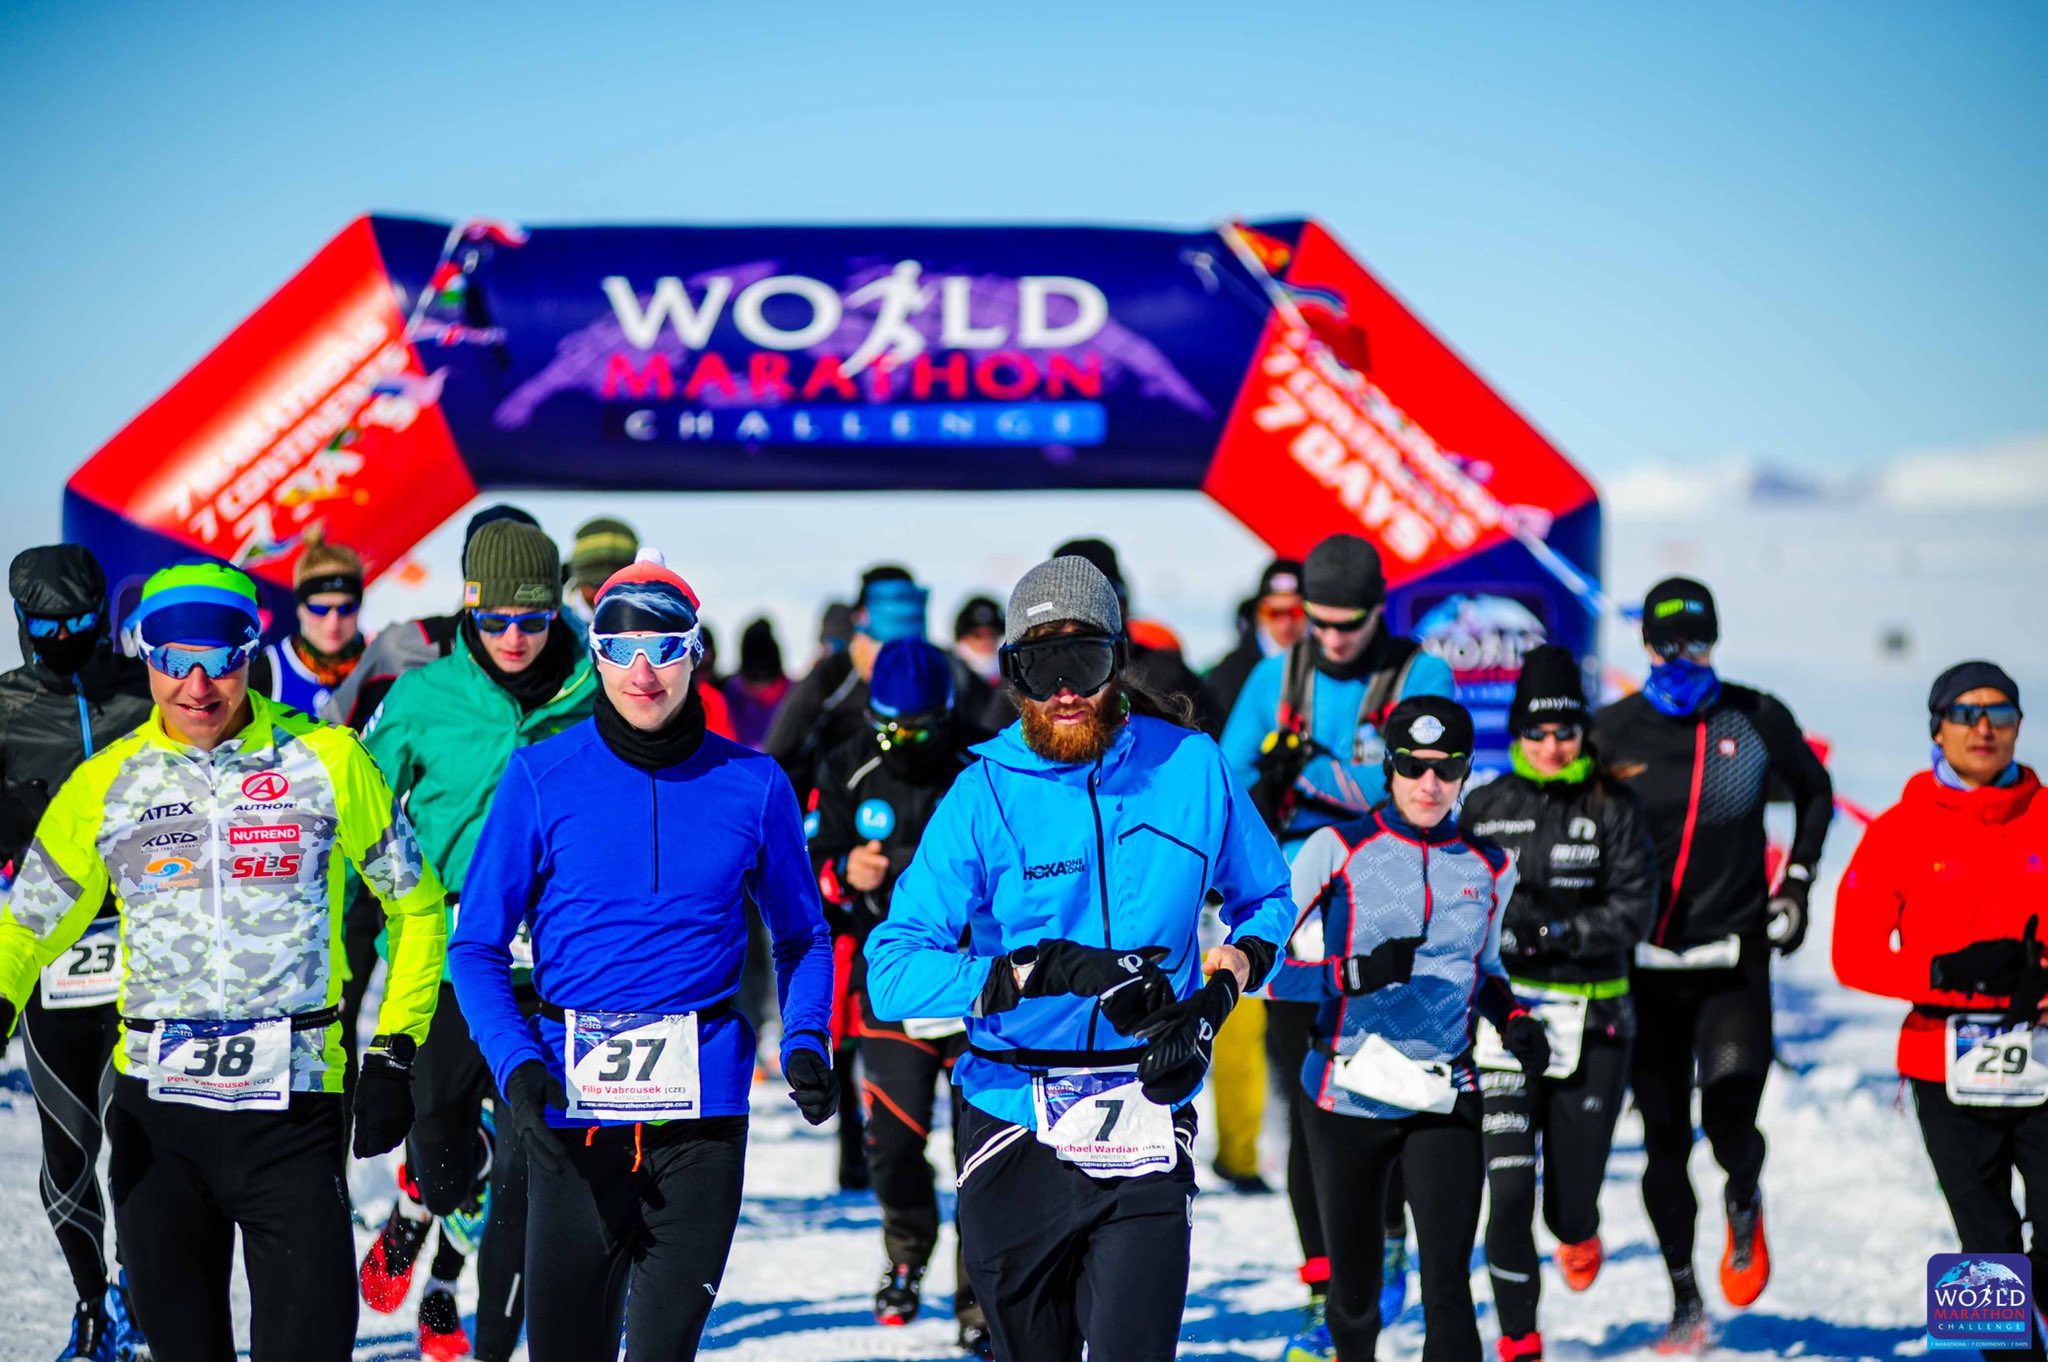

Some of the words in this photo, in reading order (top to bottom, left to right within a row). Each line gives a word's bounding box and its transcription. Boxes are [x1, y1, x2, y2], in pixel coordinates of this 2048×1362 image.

[602, 351, 1101, 399] MARATHON
[623, 409, 1074, 441] CHALLENGE
[189, 506, 219, 543] 7
[216, 343, 411, 516] CONTINENTS
[1254, 388, 1306, 432] 7
[1291, 422, 1434, 562] DAYS
[139, 801, 193, 822] ATEX
[233, 803, 293, 812] AUTHOR
[142, 833, 198, 848] TUFO
[233, 829, 296, 841] NUTREND
[1023, 861, 1067, 880] HOKA
[1065, 858, 1083, 867] ONE
[1067, 864, 1085, 874] ONE
[69, 944, 116, 976] 23
[184, 1036, 256, 1077] 38
[598, 1038, 667, 1082] 37
[1976, 1045, 2028, 1074] 29
[167, 1075, 189, 1083] Petr
[192, 1078, 250, 1089] Vabrousek
[253, 1077, 275, 1085] (CZE)
[582, 1085, 602, 1095] Filip
[605, 1086, 661, 1094] Vabrousek
[1095, 1100, 1124, 1141] 7
[1095, 1145, 1139, 1153] Wardian
